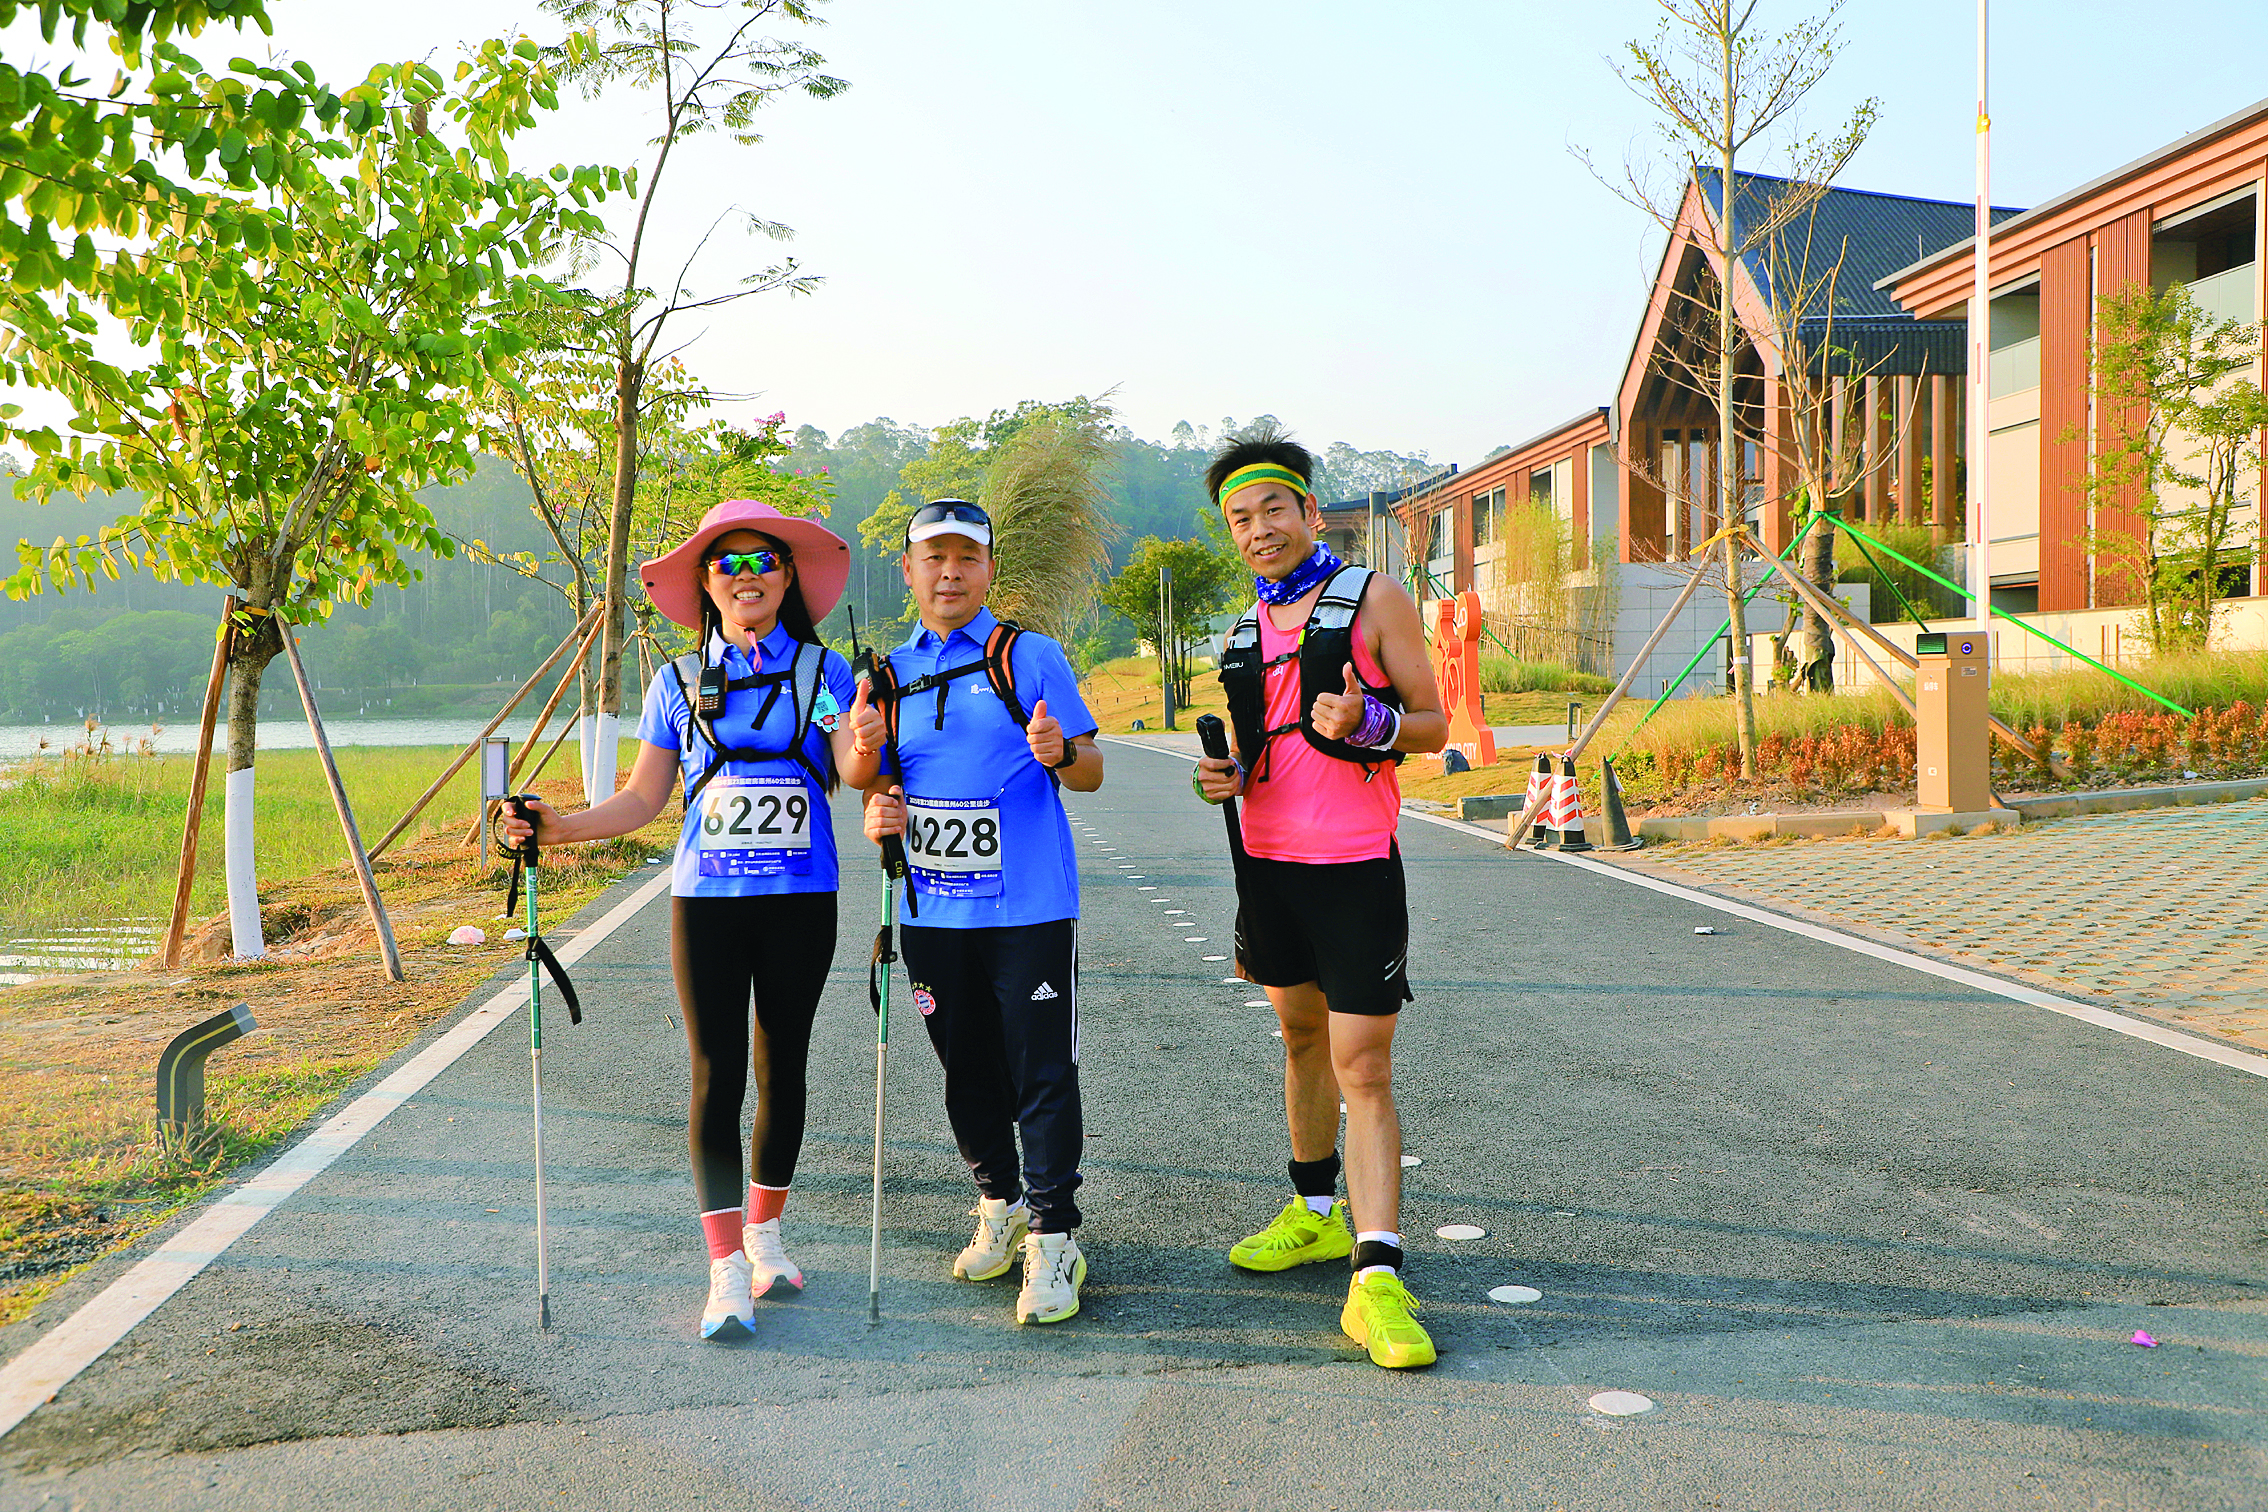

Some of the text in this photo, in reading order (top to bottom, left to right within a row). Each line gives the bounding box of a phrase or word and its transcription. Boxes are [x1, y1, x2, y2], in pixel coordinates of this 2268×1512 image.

[704, 794, 807, 836] 6229
[911, 815, 999, 858] 6228
[1031, 991, 1059, 1001] adidas
